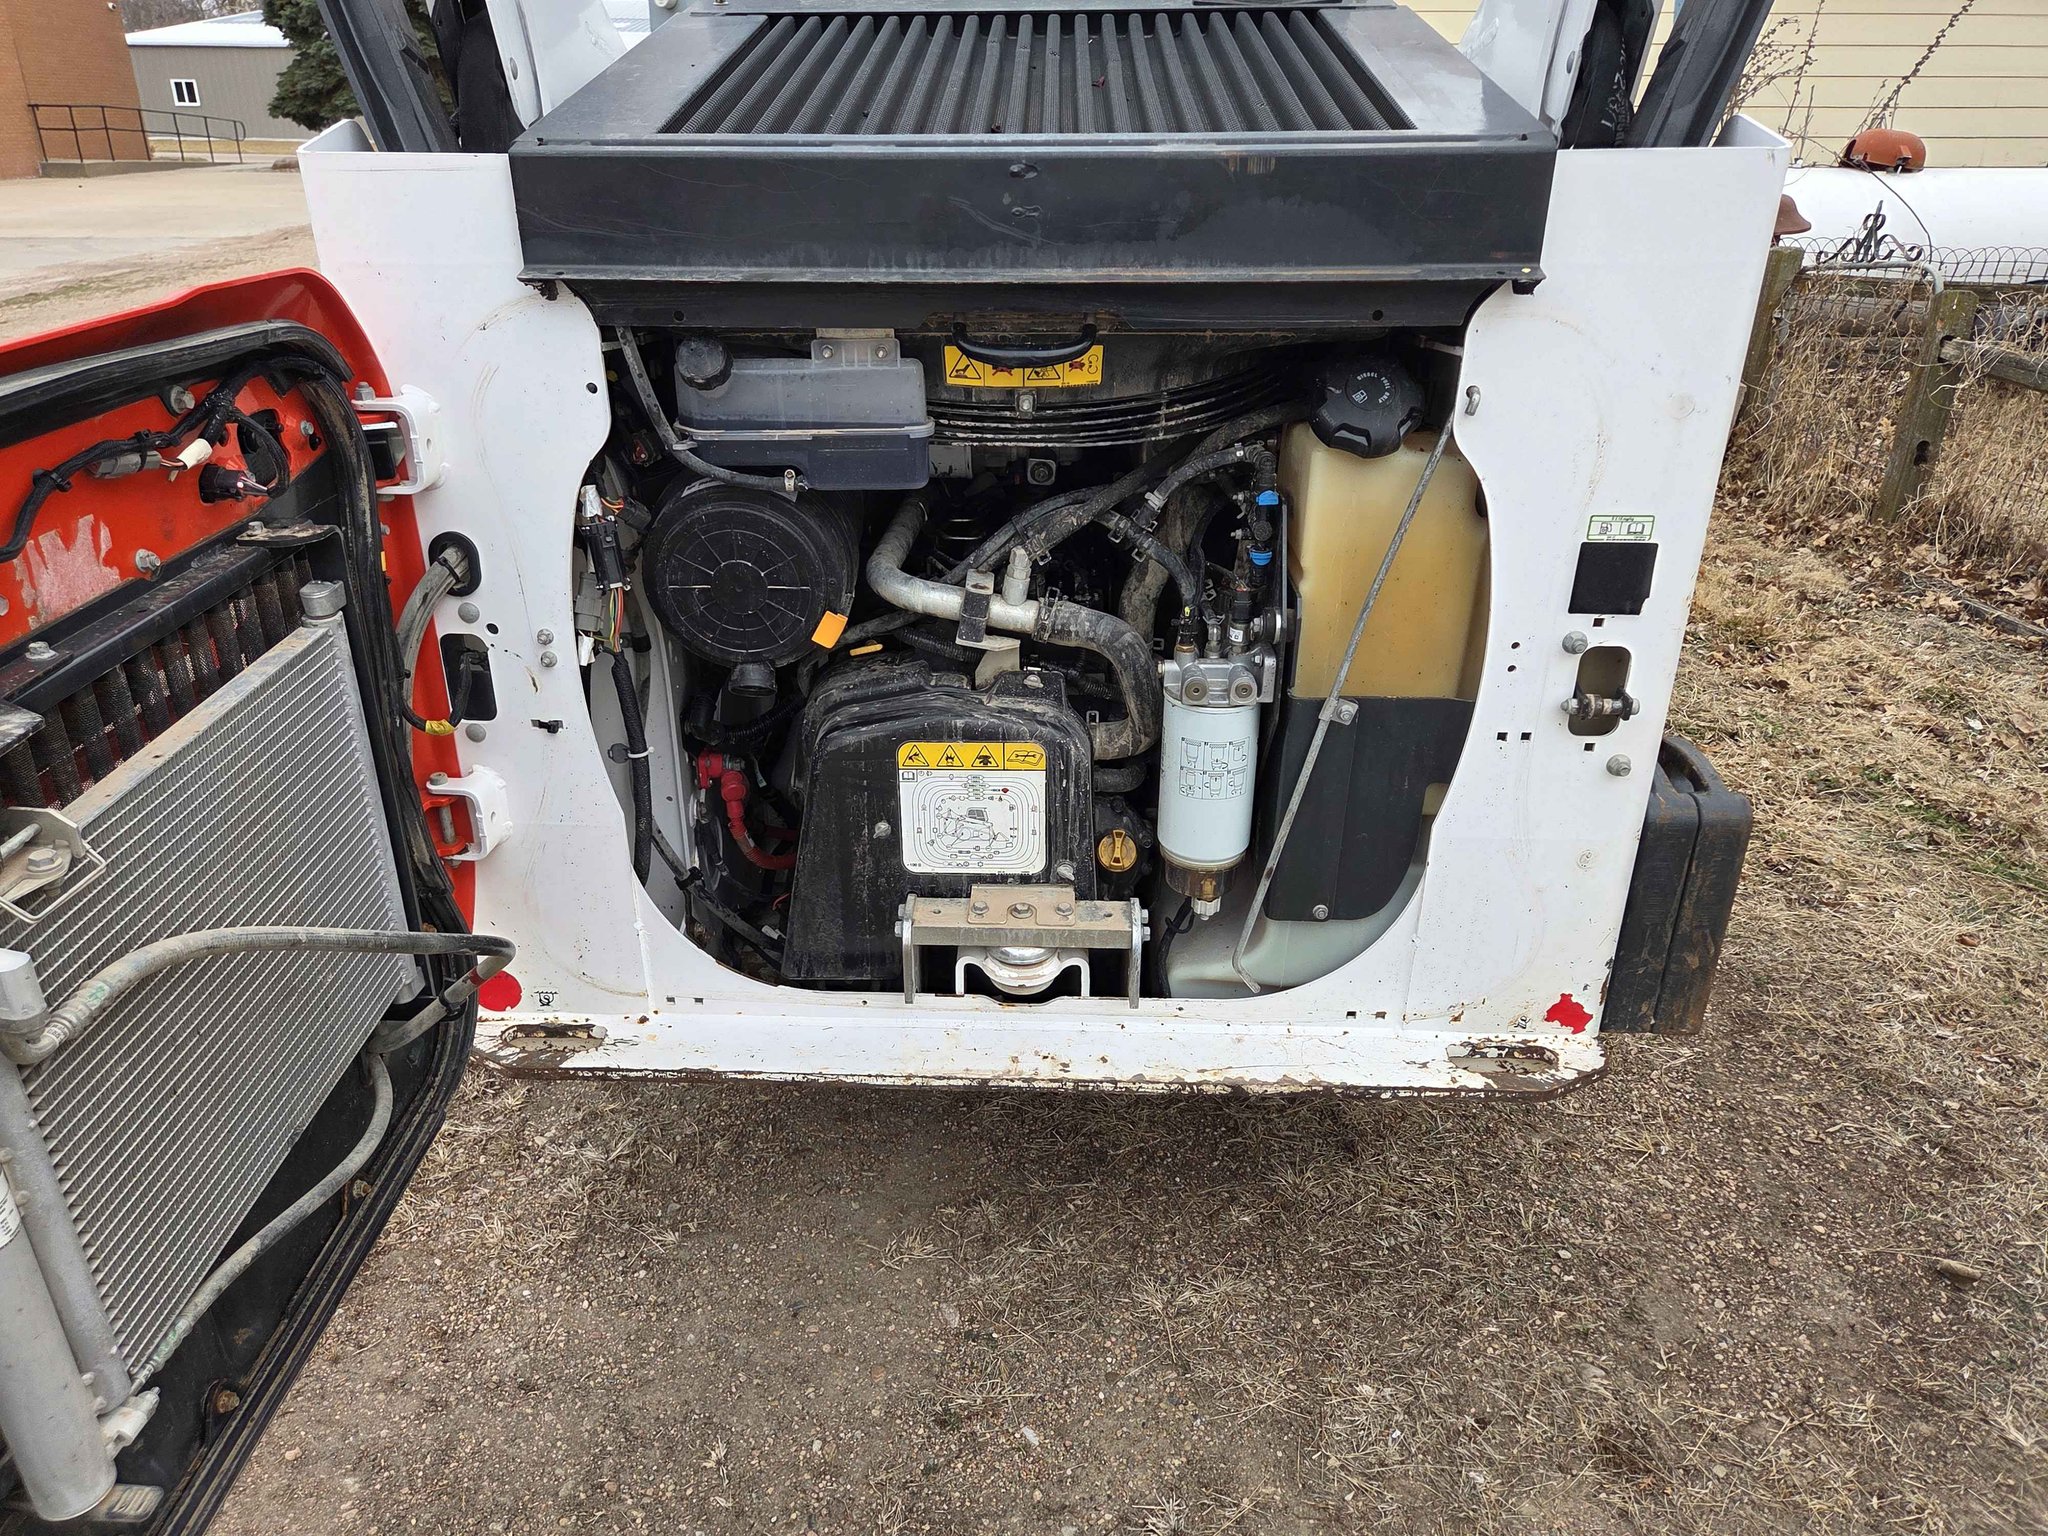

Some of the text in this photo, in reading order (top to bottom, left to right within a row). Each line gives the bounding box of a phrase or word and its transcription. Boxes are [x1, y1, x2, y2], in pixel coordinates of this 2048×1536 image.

[1357, 372, 1391, 404] DIESEL FUEL ONLY
